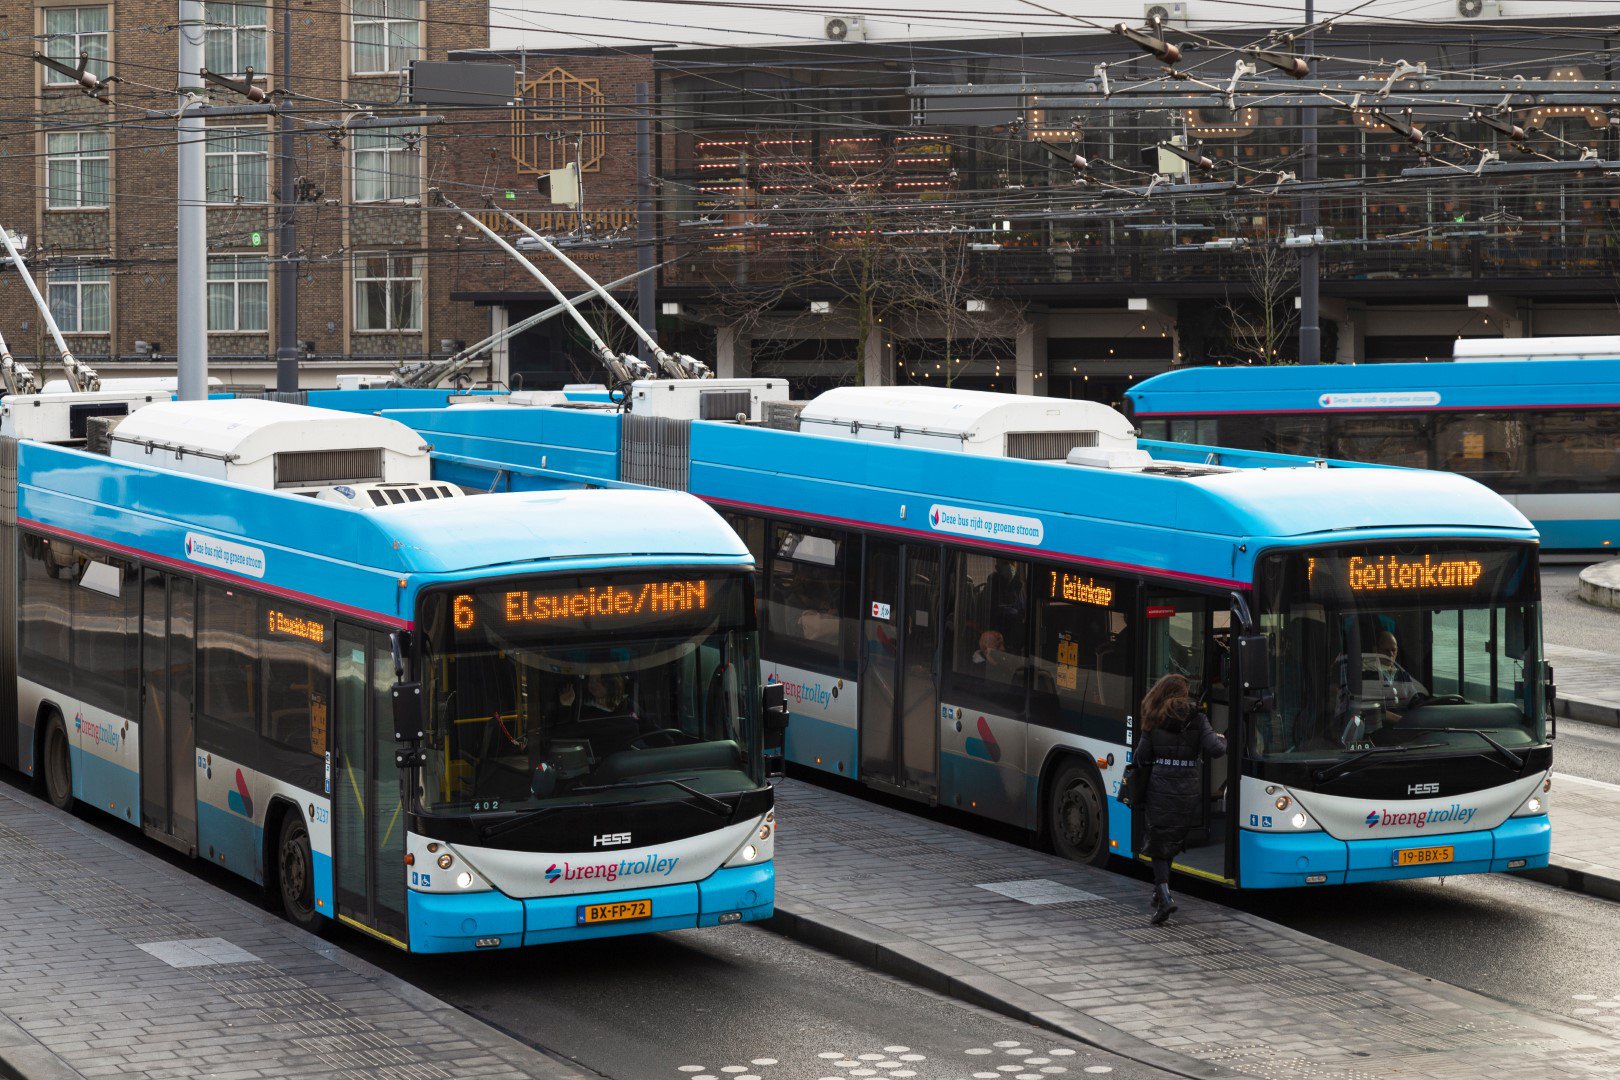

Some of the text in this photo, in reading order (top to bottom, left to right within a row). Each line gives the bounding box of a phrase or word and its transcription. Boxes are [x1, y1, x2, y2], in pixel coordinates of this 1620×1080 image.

[521, 251, 546, 261] ouse
[564, 250, 600, 262] eritage
[941, 511, 1039, 537] Deze bus rijdt op groene stroom
[193, 540, 204, 554] Deze
[205, 542, 213, 556] bus
[1349, 554, 1482, 590] Geitenkamp
[1063, 573, 1113, 606] Geitenkamp
[453, 580, 706, 629] 6 Elsweide/HAN
[269, 610, 275, 632] 6
[80, 712, 120, 752] brengtrolley
[1407, 783, 1440, 795] HESS
[316, 806, 329, 825] 5237
[1381, 804, 1478, 828] brengtrolley
[593, 832, 632, 847] HESS
[1403, 848, 1449, 863] 19-BBX-5
[564, 854, 680, 882] brengtrolley
[591, 902, 646, 920] BX-FP-72
